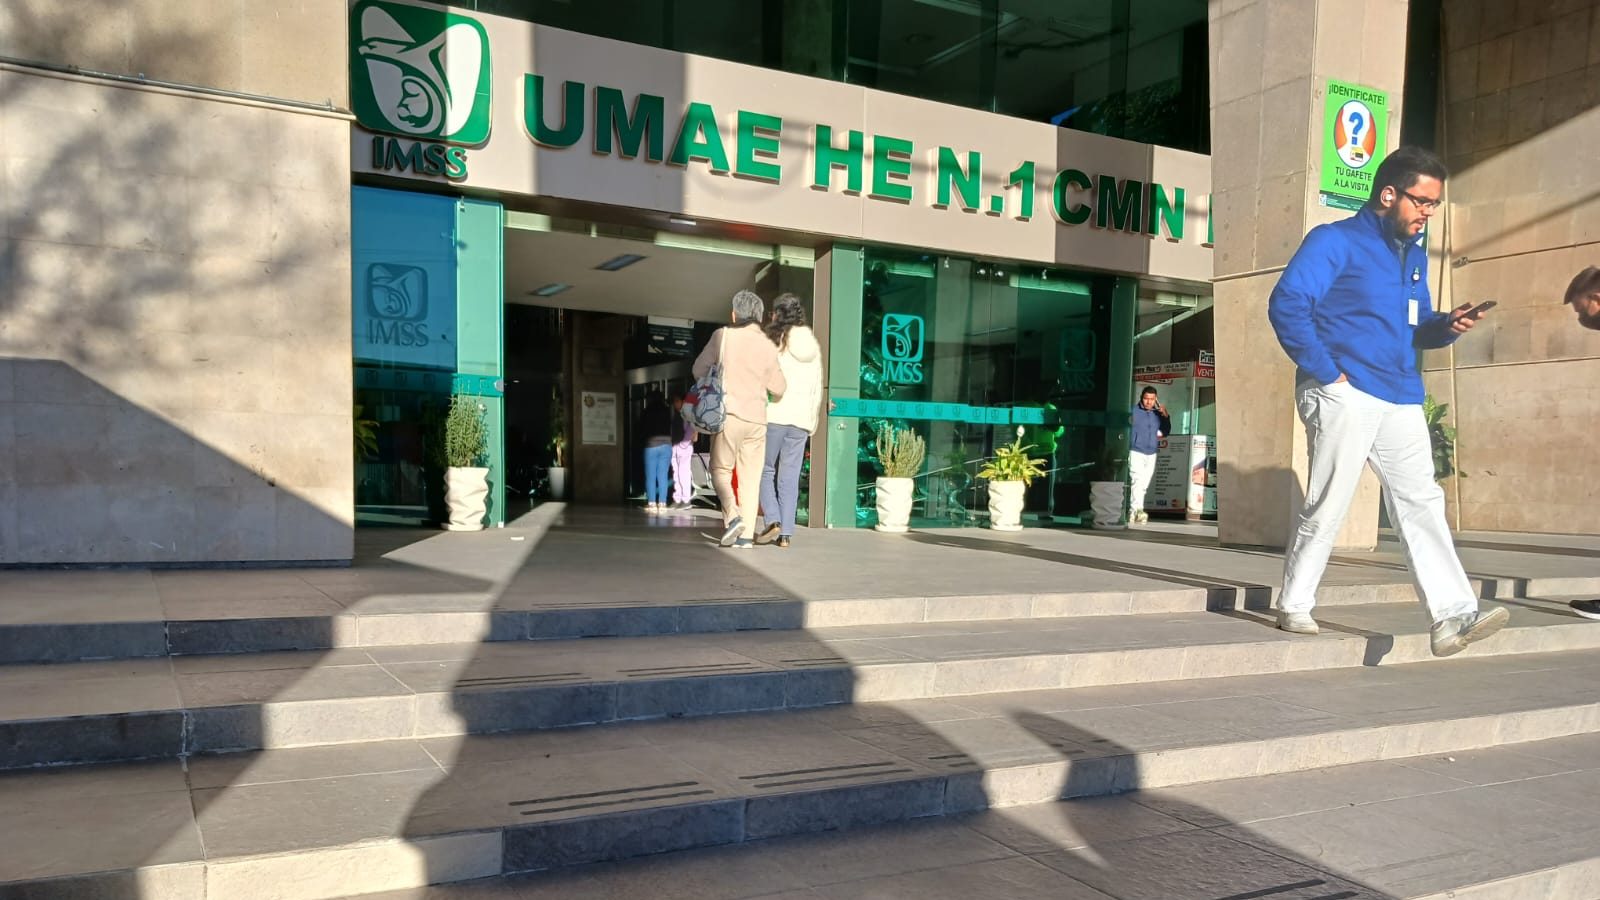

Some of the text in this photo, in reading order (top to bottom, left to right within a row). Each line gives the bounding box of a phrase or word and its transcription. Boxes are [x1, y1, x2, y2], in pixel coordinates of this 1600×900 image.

[371, 135, 469, 181] IMSS
[522, 73, 783, 184] UMAE
[812, 123, 914, 204] HE
[1053, 168, 1186, 241] CMN
[1335, 166, 1372, 182] TU GAFETE
[1340, 179, 1349, 188] LA
[1350, 181, 1369, 192] VISTA
[367, 319, 429, 347] IMSS
[881, 360, 924, 384] IMSS
